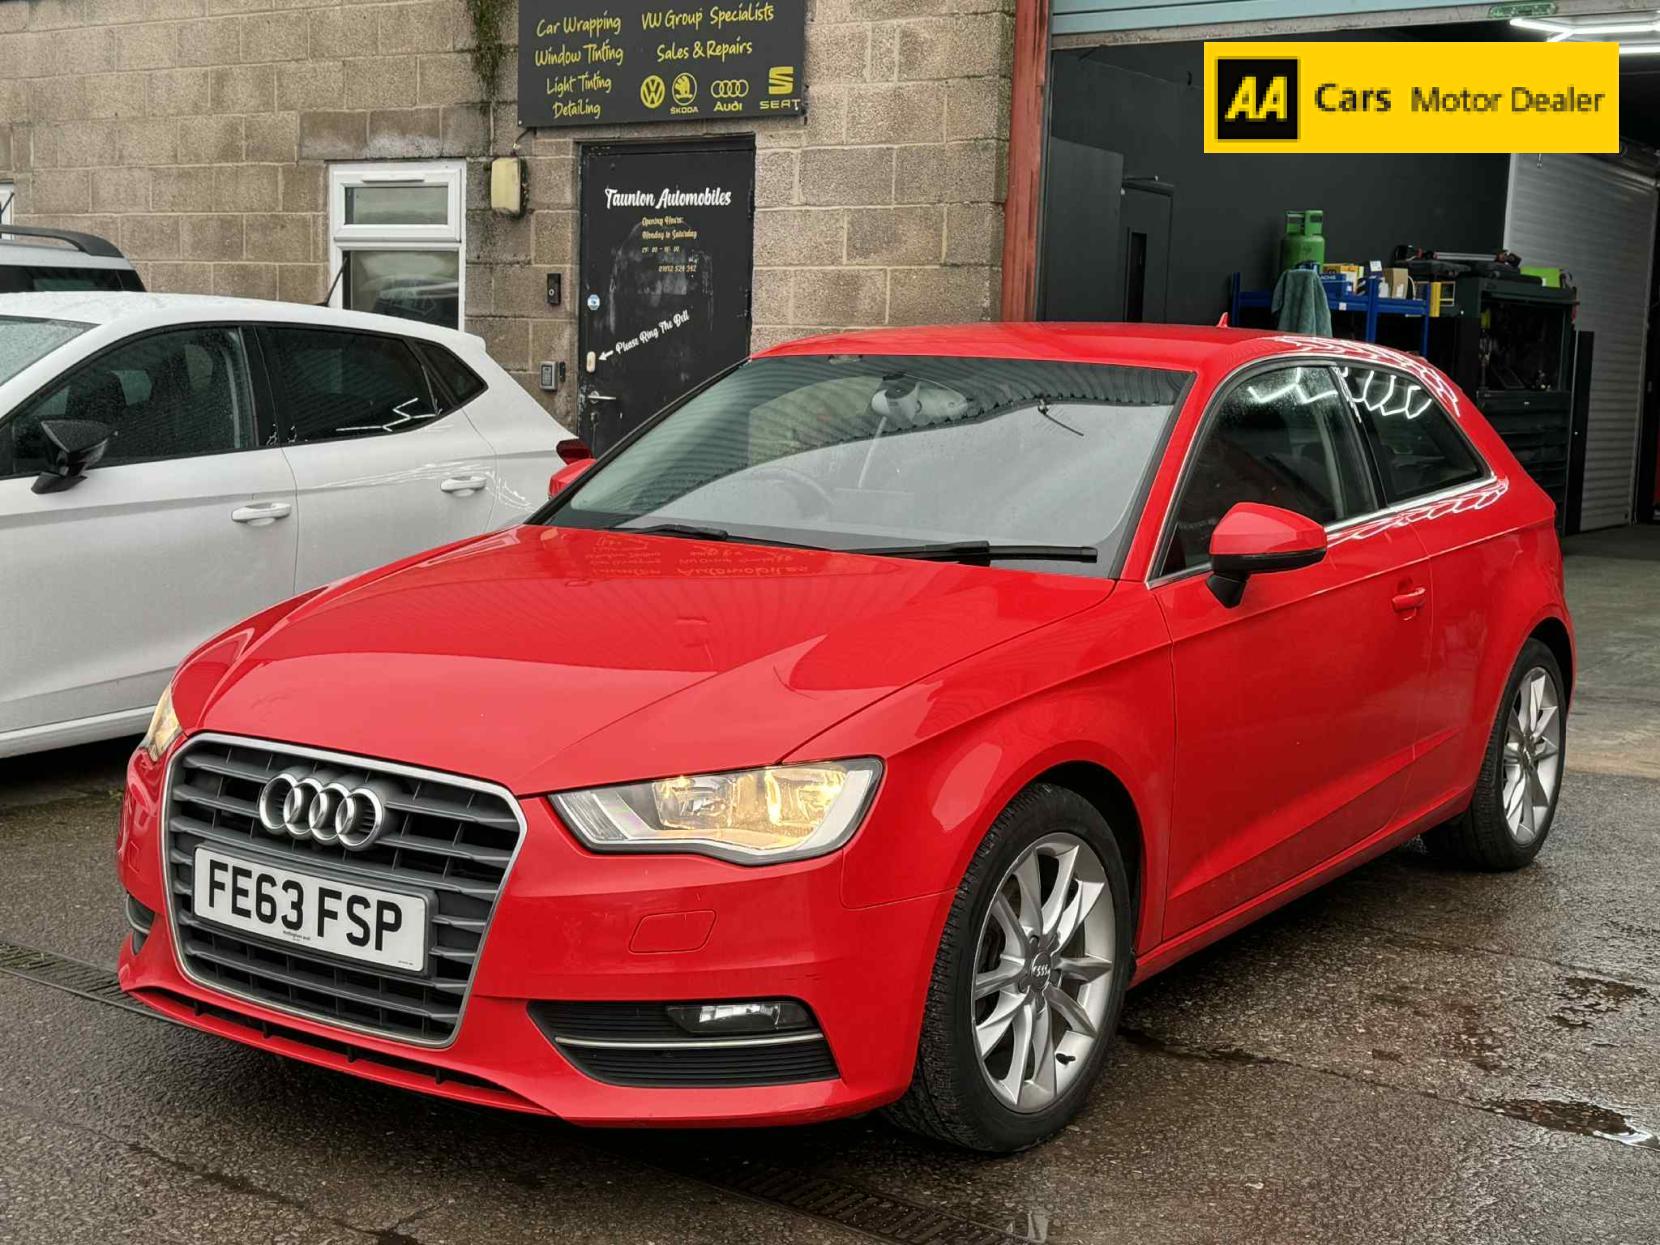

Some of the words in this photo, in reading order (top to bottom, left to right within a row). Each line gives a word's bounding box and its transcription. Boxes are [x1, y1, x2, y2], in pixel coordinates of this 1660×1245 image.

[536, 19, 560, 37] Car
[563, 10, 621, 38] Wrapping
[641, 12, 662, 30] VW
[665, 8, 703, 30] Group
[710, 2, 775, 29] Specialists
[535, 46, 581, 66] Window
[582, 38, 624, 66] Tinting
[657, 42, 689, 62] Sales
[692, 41, 705, 58] &
[706, 36, 753, 62] Repairs
[547, 75, 576, 97] Light
[578, 70, 612, 93] Tinting
[552, 98, 601, 119] Detailing
[714, 101, 743, 111] Audi
[759, 99, 800, 110] SEAT
[605, 188, 656, 209] Taunton
[655, 187, 732, 209] Automobiles
[615, 338, 640, 354] Please
[639, 327, 659, 344] Ring
[658, 319, 673, 334] The
[673, 309, 690, 327] Bell
[208, 859, 304, 931] FE63
[316, 886, 402, 951] FSP
